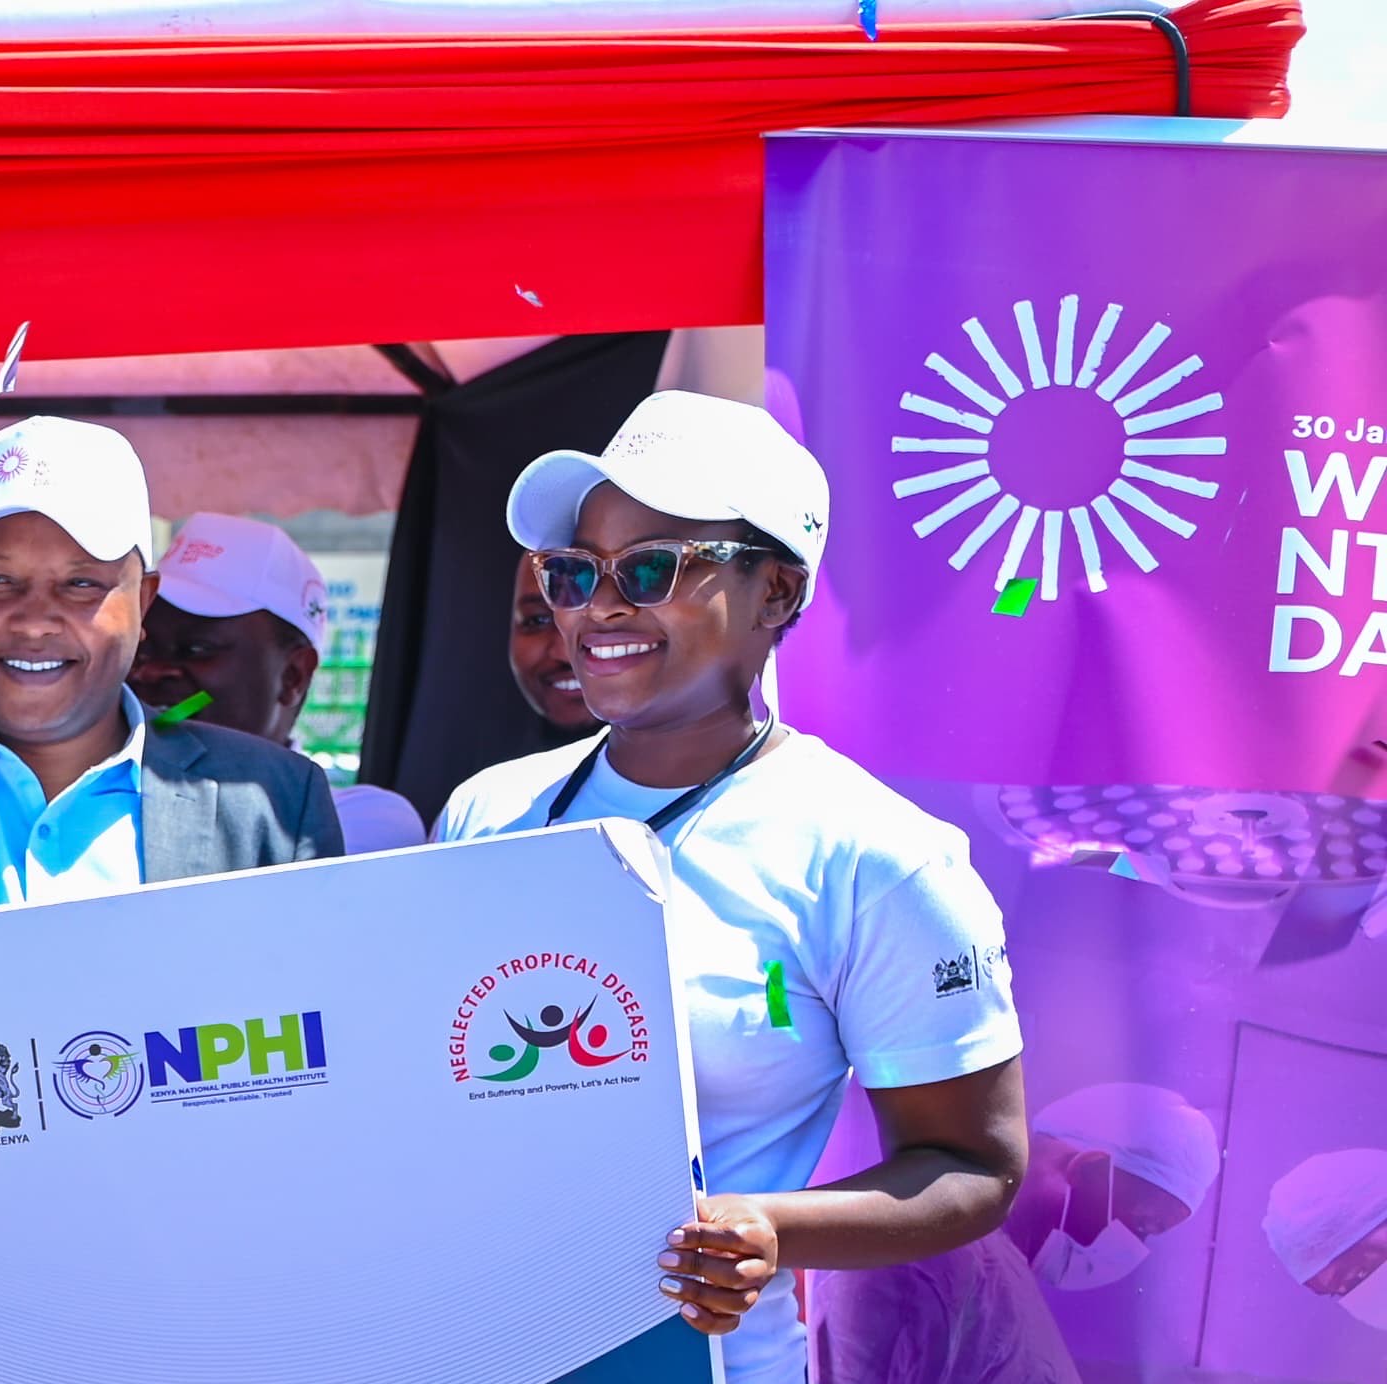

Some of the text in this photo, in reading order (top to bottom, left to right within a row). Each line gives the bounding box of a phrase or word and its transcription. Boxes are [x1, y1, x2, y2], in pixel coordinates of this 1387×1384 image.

[1291, 414, 1387, 444] 30 Ja
[1268, 604, 1387, 677] DA
[496, 953, 599, 979] TROPICAL
[449, 975, 496, 1082] NEGLECTED
[601, 972, 648, 1063] DISEASES
[144, 1010, 327, 1087] NPHI
[150, 1072, 326, 1098] KENYA NATIONAL PUBLIC HEALTH INSTITUTE
[263, 1089, 292, 1099] Trusted
[469, 1092, 485, 1100] End
[487, 1086, 525, 1099] Suffering
[527, 1085, 543, 1094] and
[545, 1082, 579, 1093] Poverty,
[604, 1077, 619, 1086] Act
[620, 1075, 640, 1084] Now
